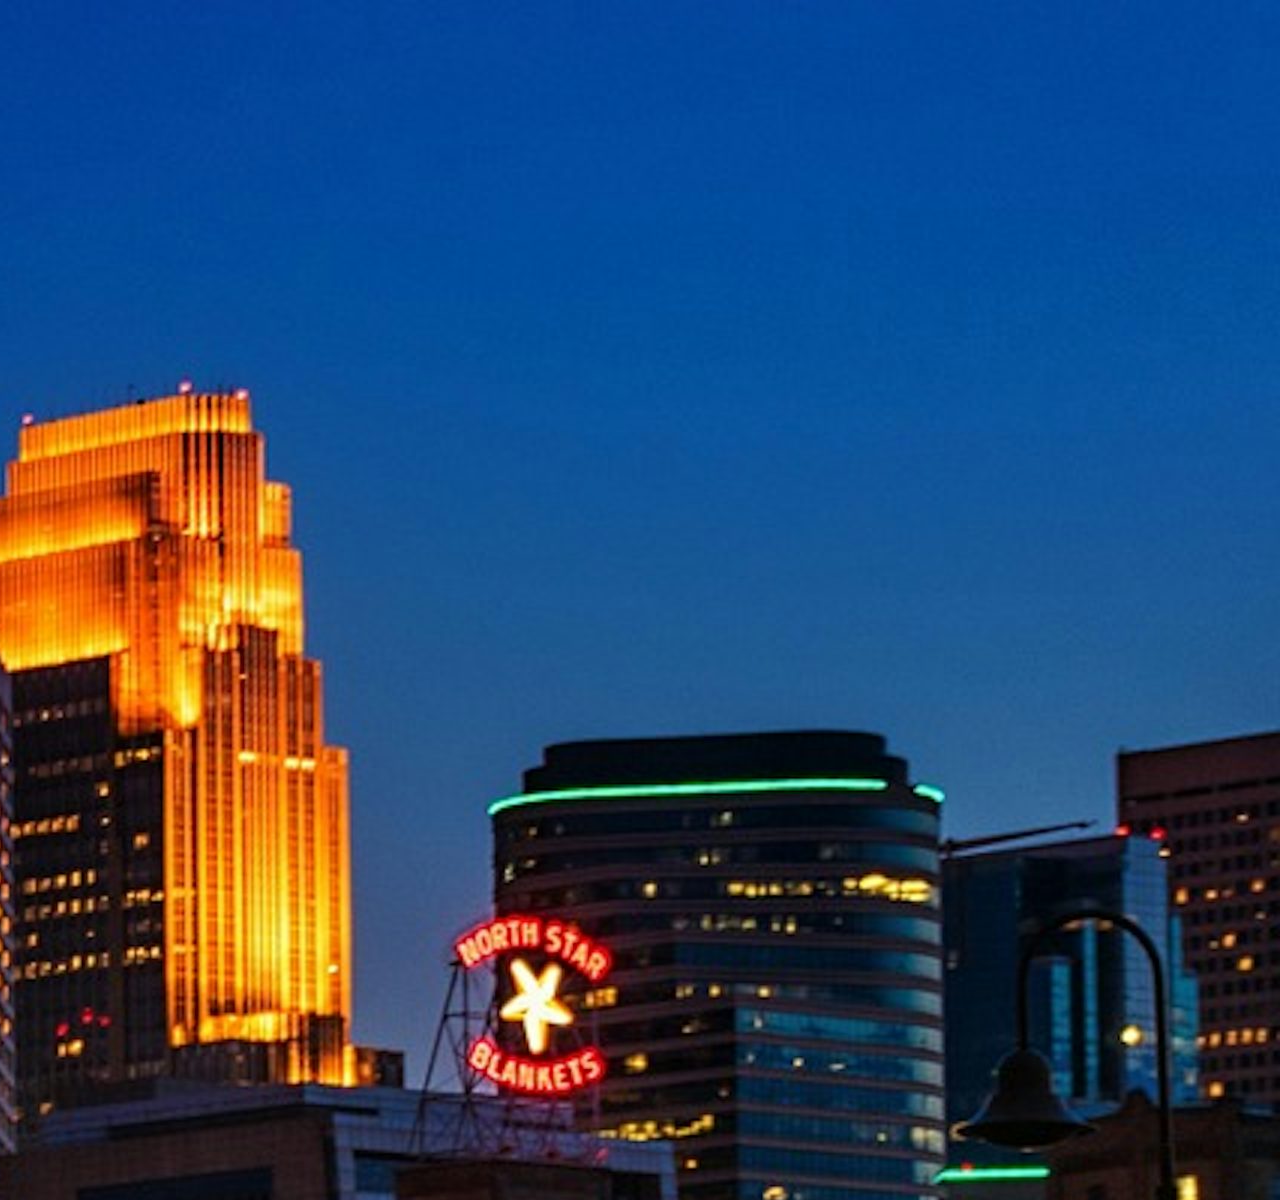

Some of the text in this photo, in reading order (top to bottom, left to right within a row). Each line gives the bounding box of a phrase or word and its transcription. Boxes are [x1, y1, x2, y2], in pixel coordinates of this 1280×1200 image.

[456, 918, 608, 980] NORTH STAR
[469, 1040, 602, 1091] BLANKETS
